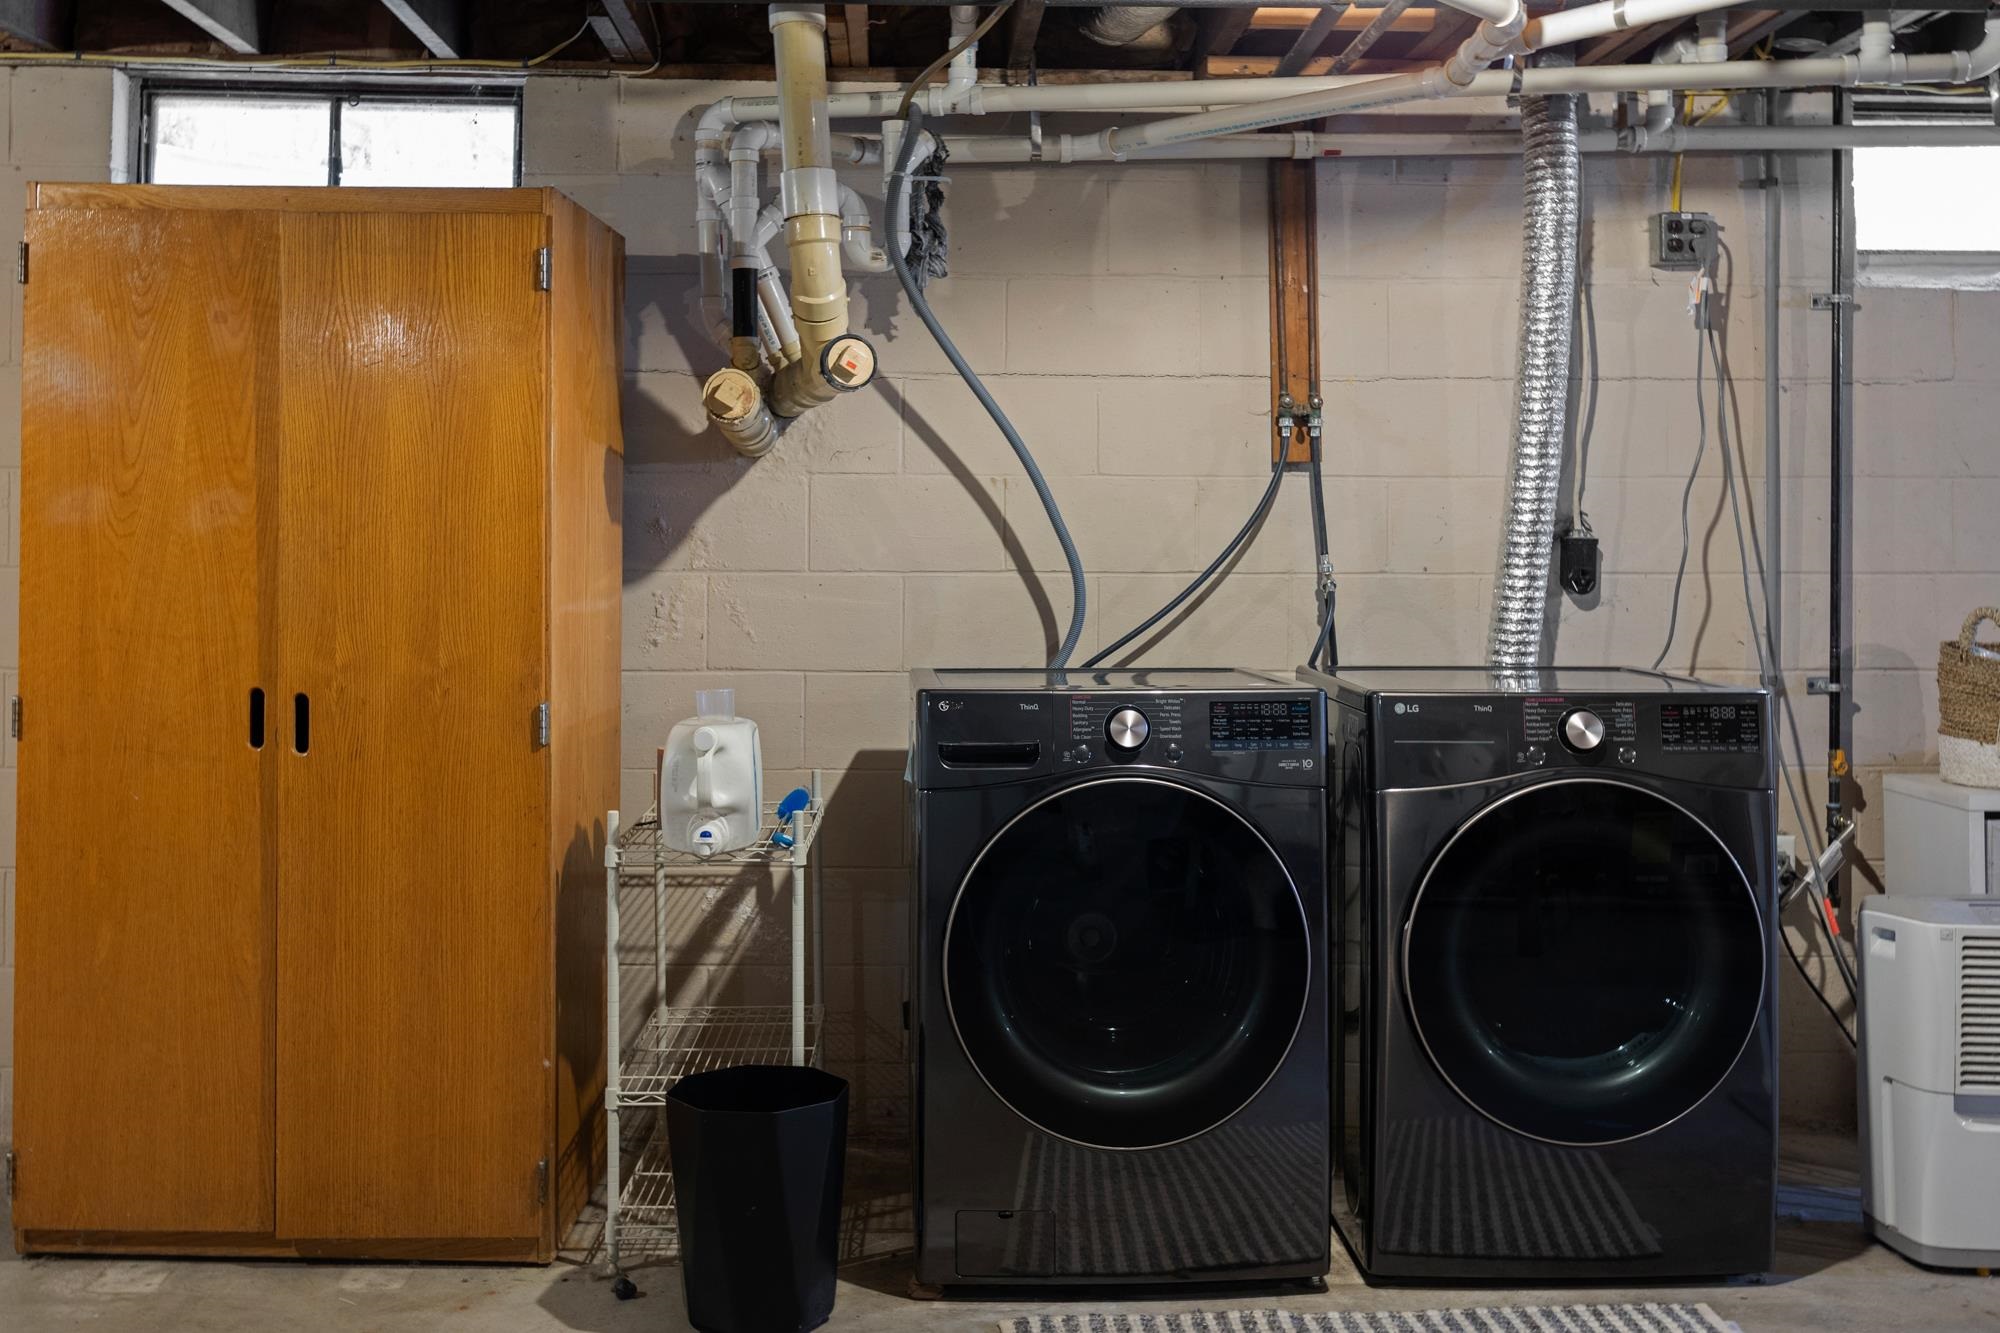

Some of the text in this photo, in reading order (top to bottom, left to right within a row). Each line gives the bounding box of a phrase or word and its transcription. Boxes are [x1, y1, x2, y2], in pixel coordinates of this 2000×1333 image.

[1019, 703, 1039, 711] ThinQ
[1407, 704, 1420, 713] LG
[1473, 704, 1493, 712] ThinQ
